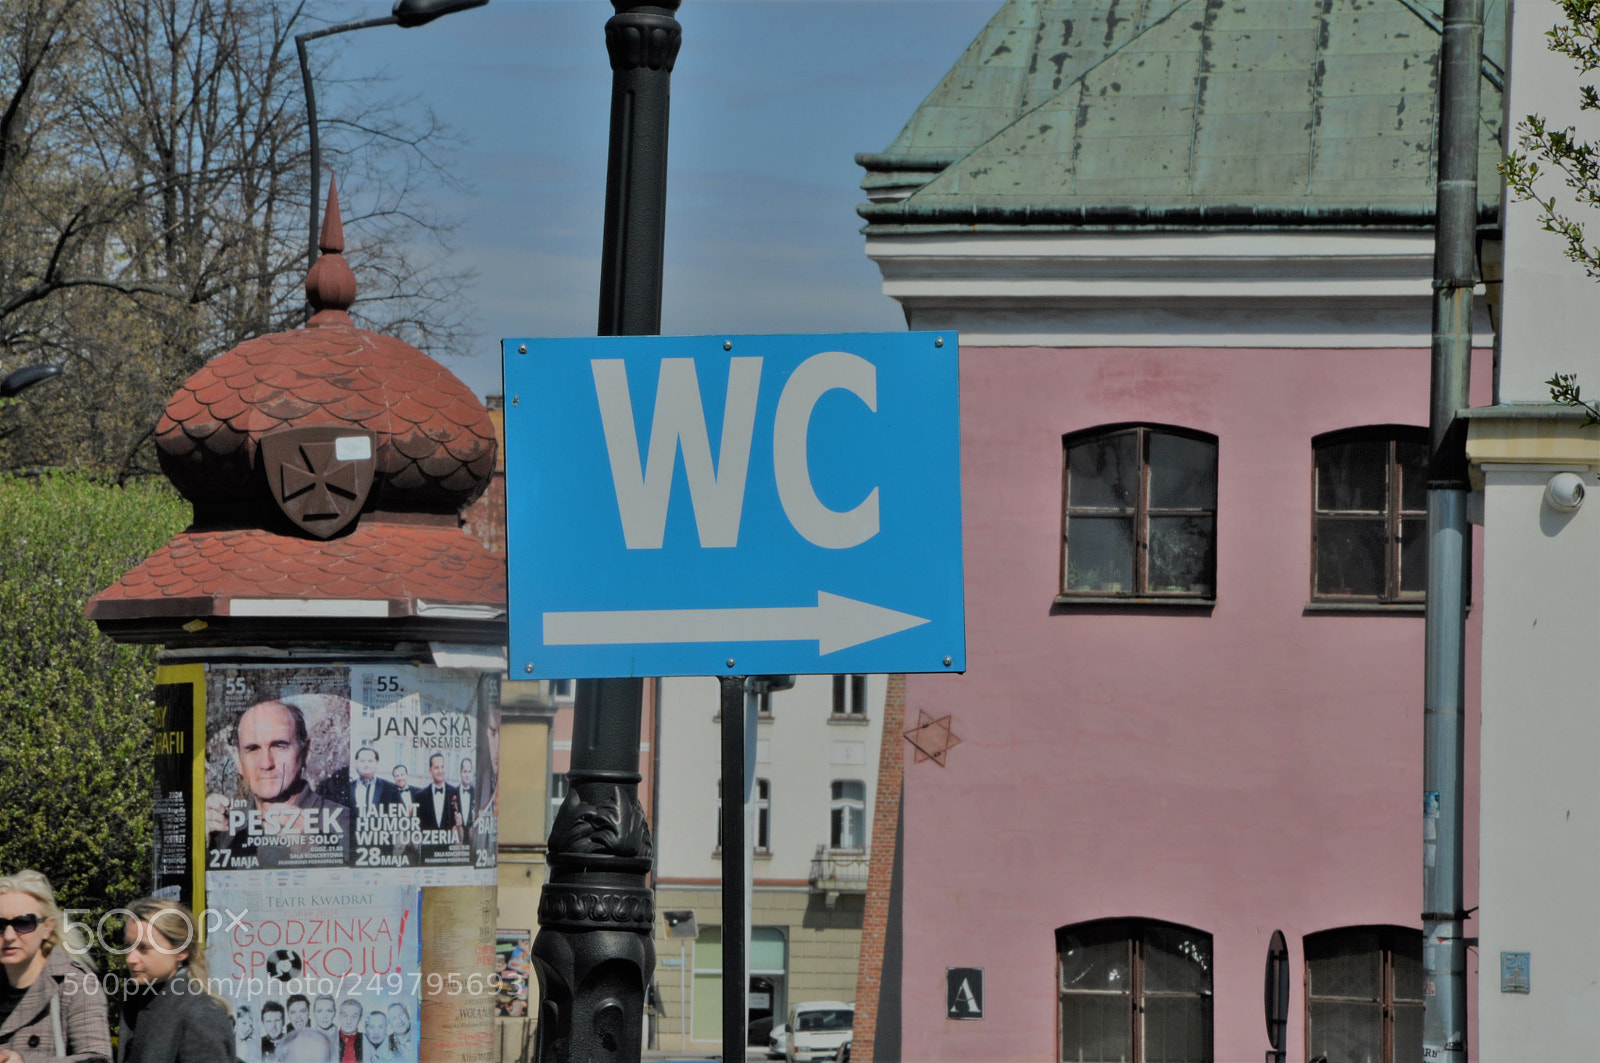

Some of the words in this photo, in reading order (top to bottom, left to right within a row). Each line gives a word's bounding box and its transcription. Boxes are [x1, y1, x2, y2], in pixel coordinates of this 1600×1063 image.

[591, 351, 881, 550] WC
[377, 675, 404, 693] 55.
[412, 736, 472, 749] ENSEMBLE
[356, 803, 420, 818] TALENT
[228, 807, 344, 836] PESZEK
[356, 817, 420, 831] HUMOR
[355, 829, 460, 846] WIRTUOZERIA
[209, 849, 232, 868] 27
[231, 856, 259, 869] MAJA
[355, 847, 381, 867] 28
[381, 855, 410, 868] MAJA
[475, 849, 488, 868] 29
[264, 896, 306, 909] TEATR
[311, 894, 374, 906] KWADRAT
[233, 917, 393, 948] GODZINKA
[950, 977, 981, 1013] A
